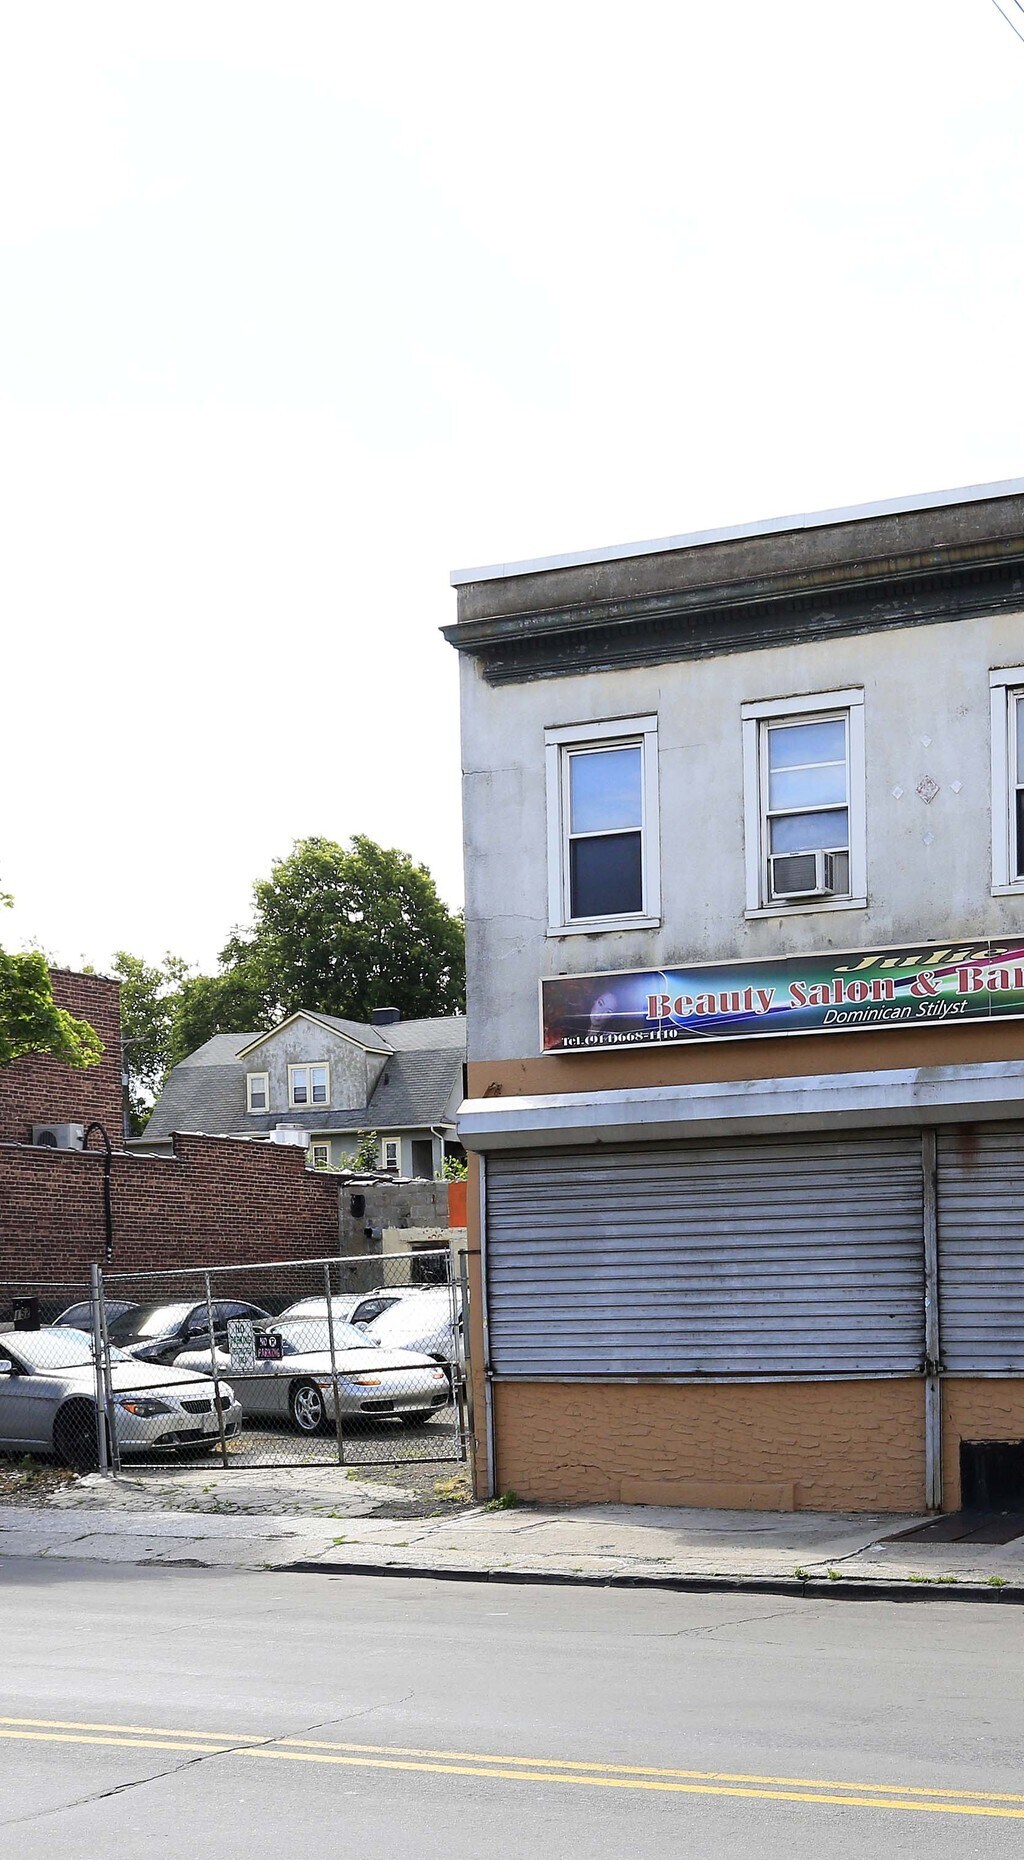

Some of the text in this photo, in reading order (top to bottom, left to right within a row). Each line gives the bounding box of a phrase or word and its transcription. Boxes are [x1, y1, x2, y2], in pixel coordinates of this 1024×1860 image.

[834, 946, 1008, 973] Julie
[645, 985, 775, 1020] Beauty
[789, 976, 896, 1009] Salon
[910, 970, 942, 998] &
[823, 999, 968, 1025] Dominican Stilyst
